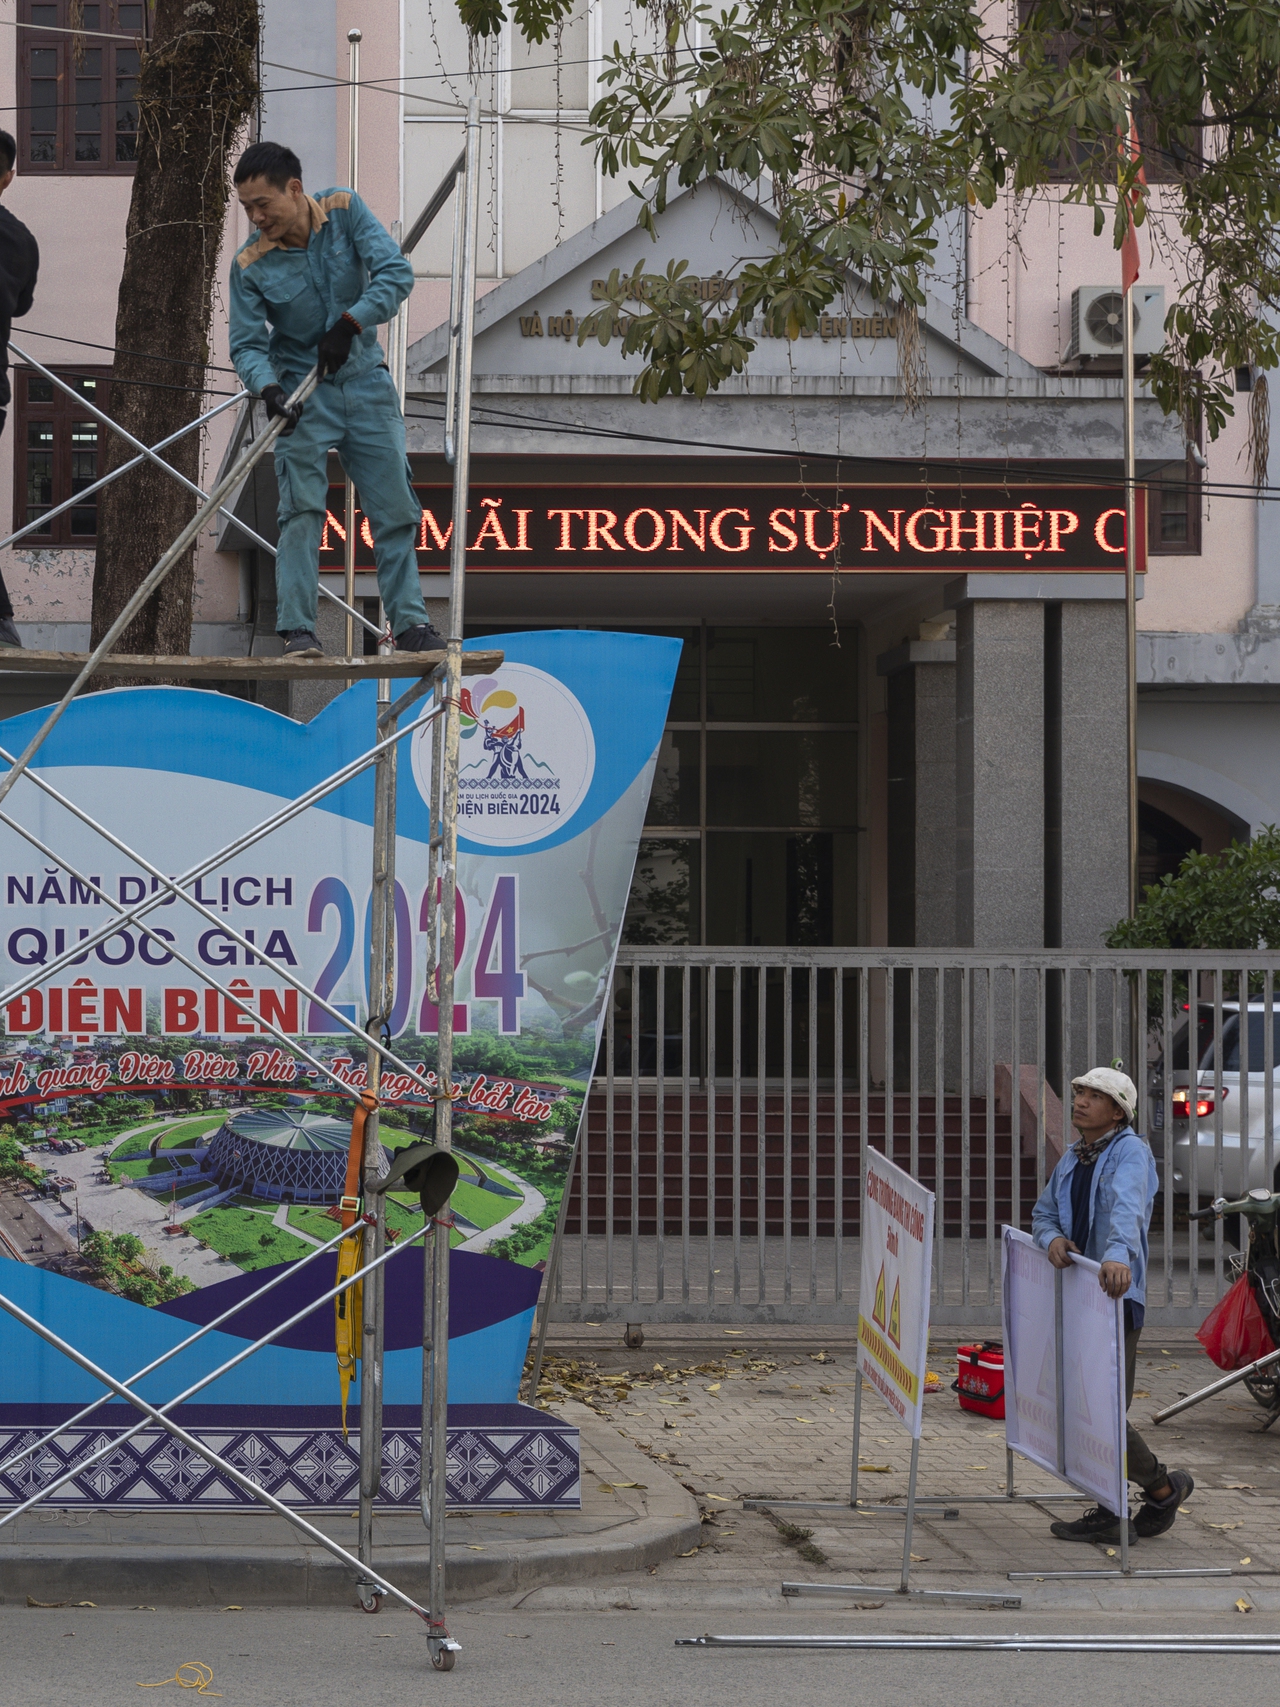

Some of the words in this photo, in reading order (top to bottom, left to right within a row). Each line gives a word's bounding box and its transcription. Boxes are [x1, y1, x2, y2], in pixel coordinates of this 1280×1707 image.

[519, 310, 544, 337] VÀ
[415, 498, 533, 551] MÃI
[547, 508, 755, 552] TRONG
[768, 503, 851, 560] SỰ
[859, 502, 1079, 561] NGHIỆP
[487, 800, 518, 814] BIÊN
[520, 794, 560, 814] 2024
[7, 868, 101, 905] NĂM
[195, 876, 293, 912] LỊCH
[197, 929, 298, 966] GIA
[307, 876, 524, 1037] 2024
[6, 978, 143, 1043] ĐIỆN
[164, 978, 298, 1034] BIÊN
[36, 1062, 110, 1097] quang
[119, 1051, 174, 1084] Điện
[184, 1050, 238, 1079] Biên
[247, 1048, 296, 1081] Phủ
[469, 1074, 514, 1110] bất
[514, 1086, 551, 1121] tận
